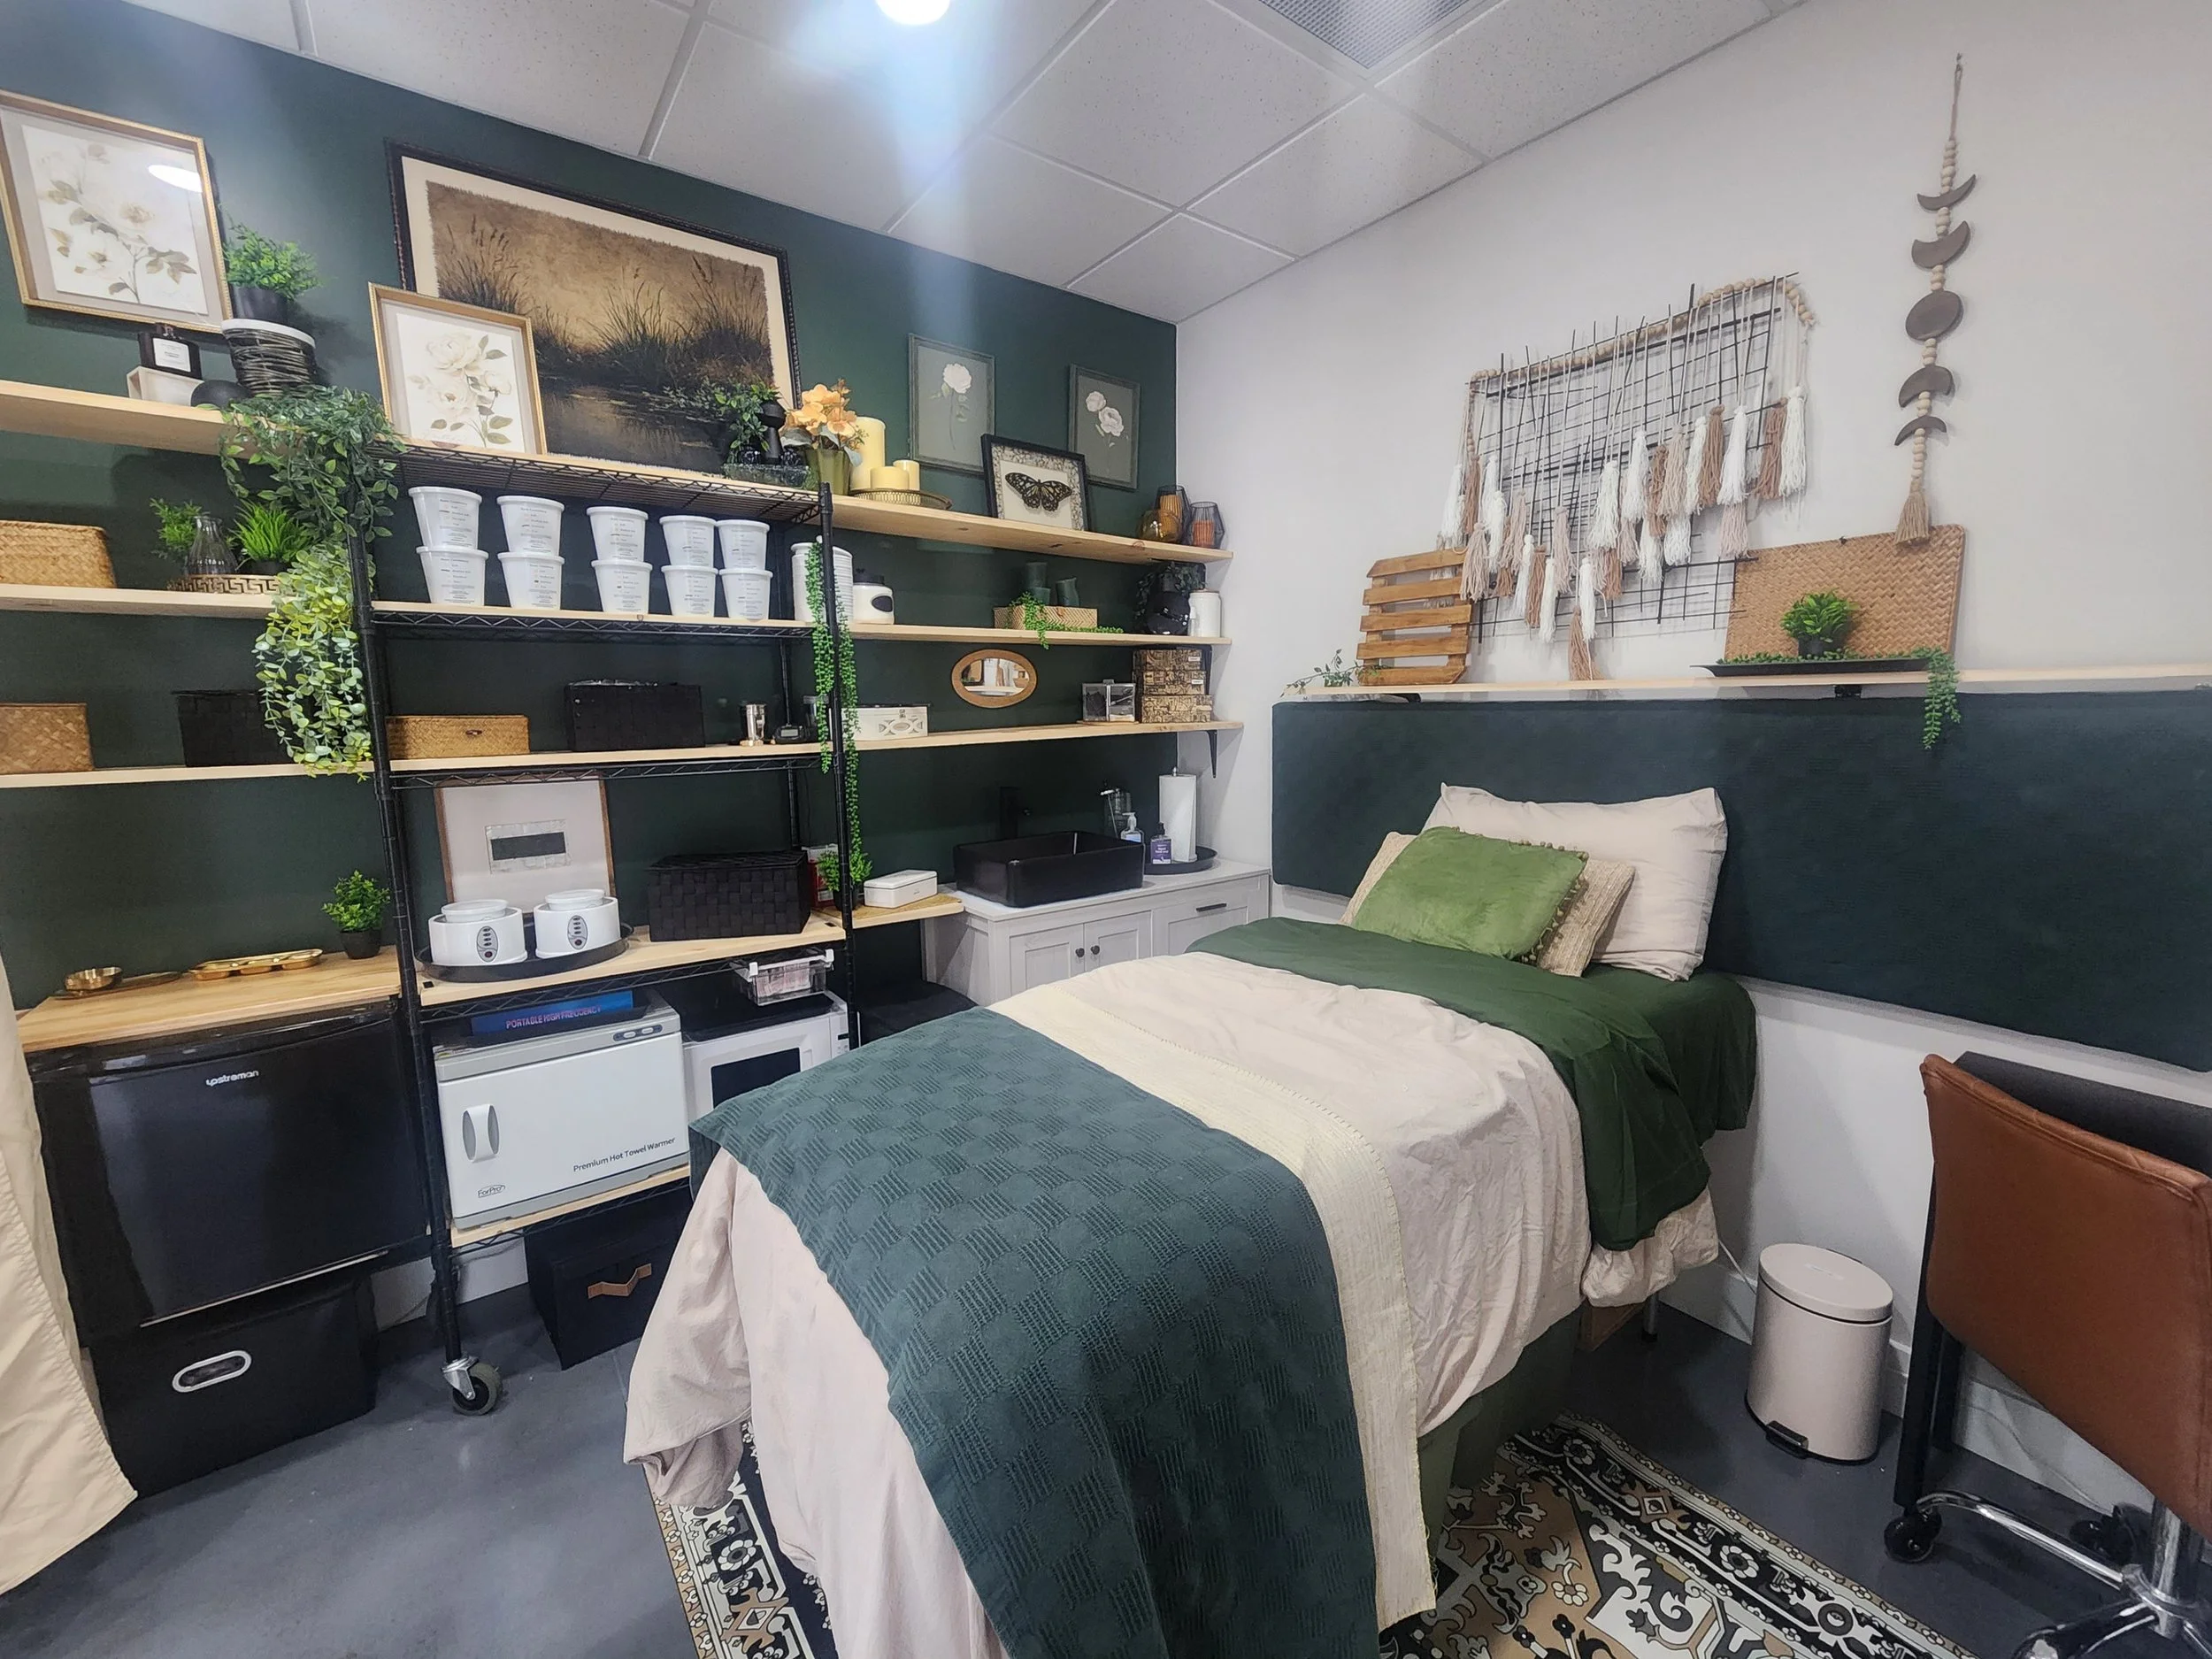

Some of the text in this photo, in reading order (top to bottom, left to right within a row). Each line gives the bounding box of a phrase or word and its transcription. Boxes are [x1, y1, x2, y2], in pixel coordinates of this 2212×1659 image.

[505, 1015, 543, 1029] PORTABLE
[543, 1011, 561, 1023] HIGH
[573, 1137, 676, 1172] Premium Hot Towel Warmer
